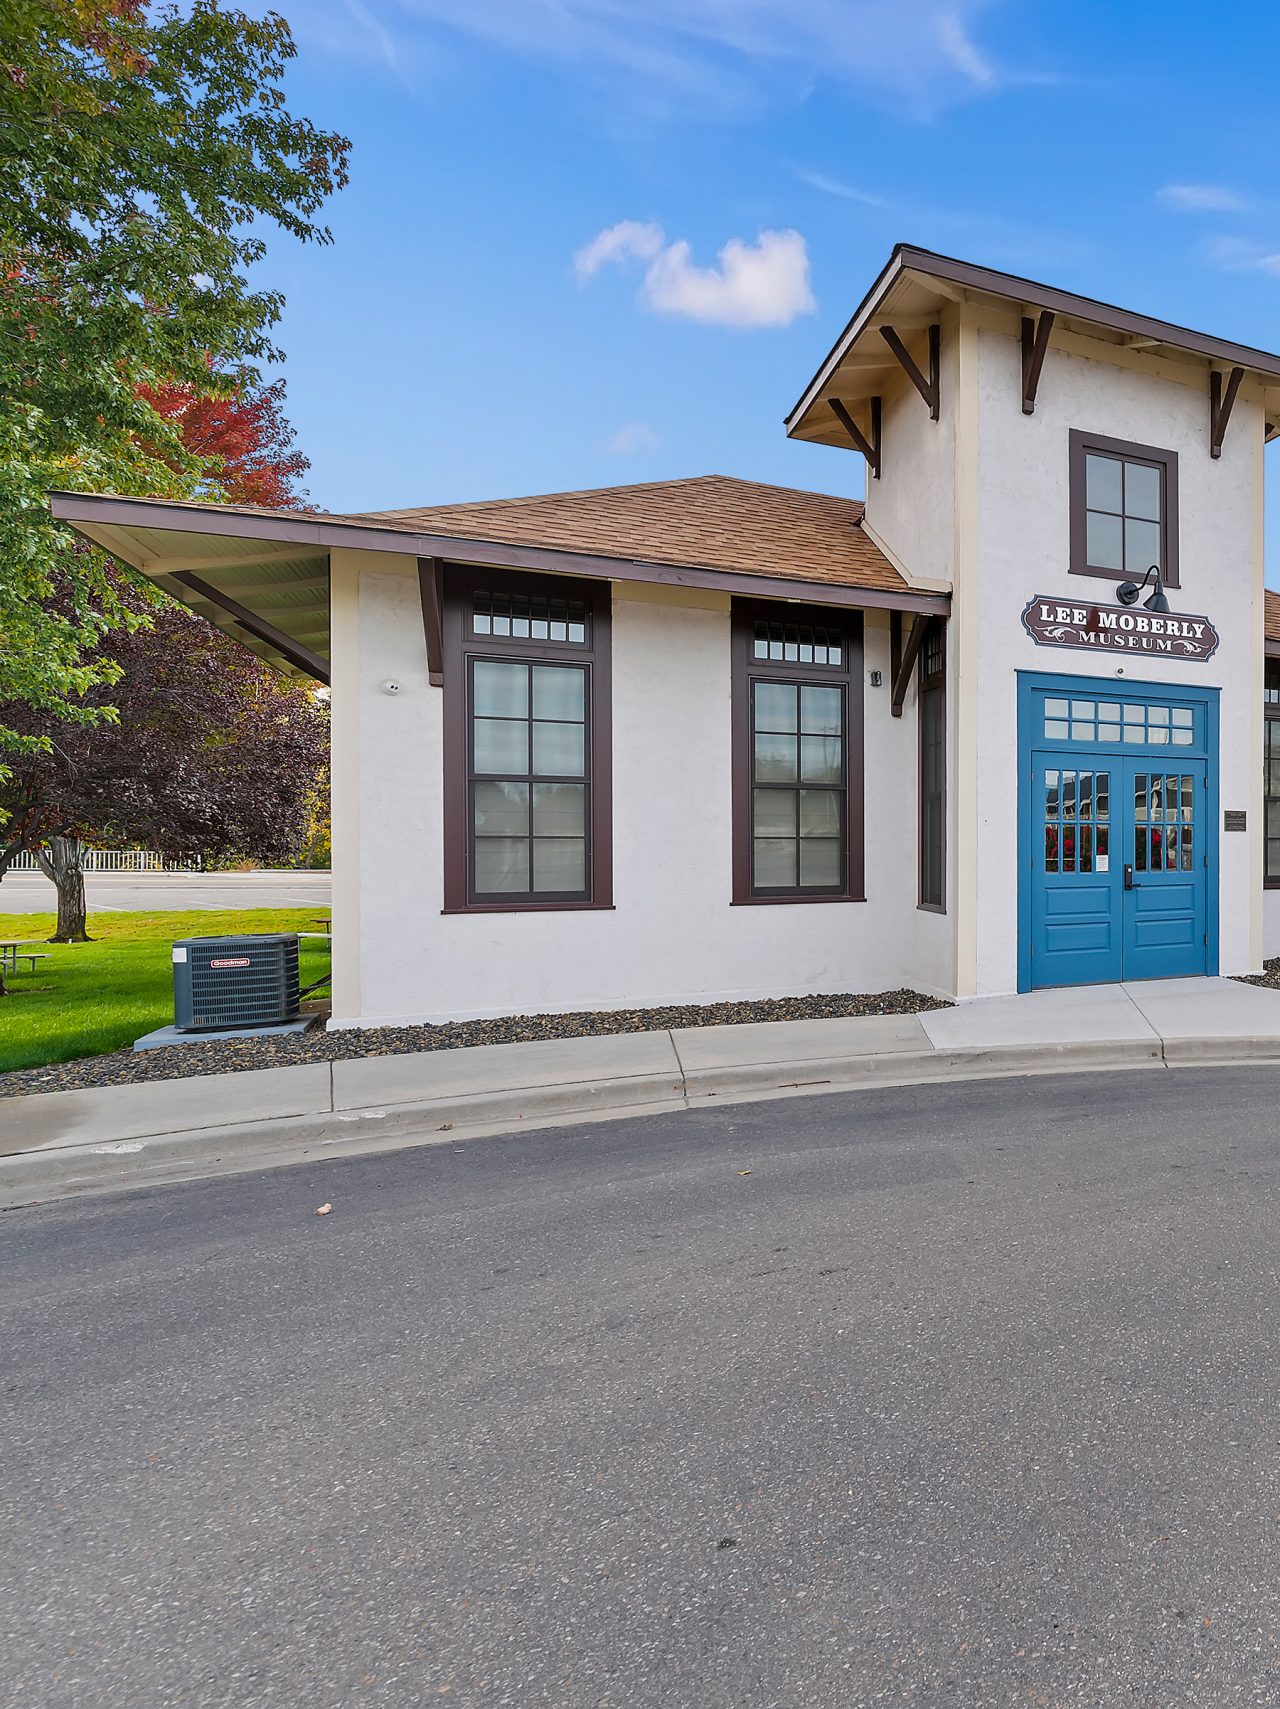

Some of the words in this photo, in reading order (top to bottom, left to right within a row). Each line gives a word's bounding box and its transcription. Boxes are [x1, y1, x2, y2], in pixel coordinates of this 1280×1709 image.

[1039, 605, 1087, 625] LEE
[1098, 612, 1205, 639] MOBERLY
[1078, 631, 1173, 652] MUSEUM
